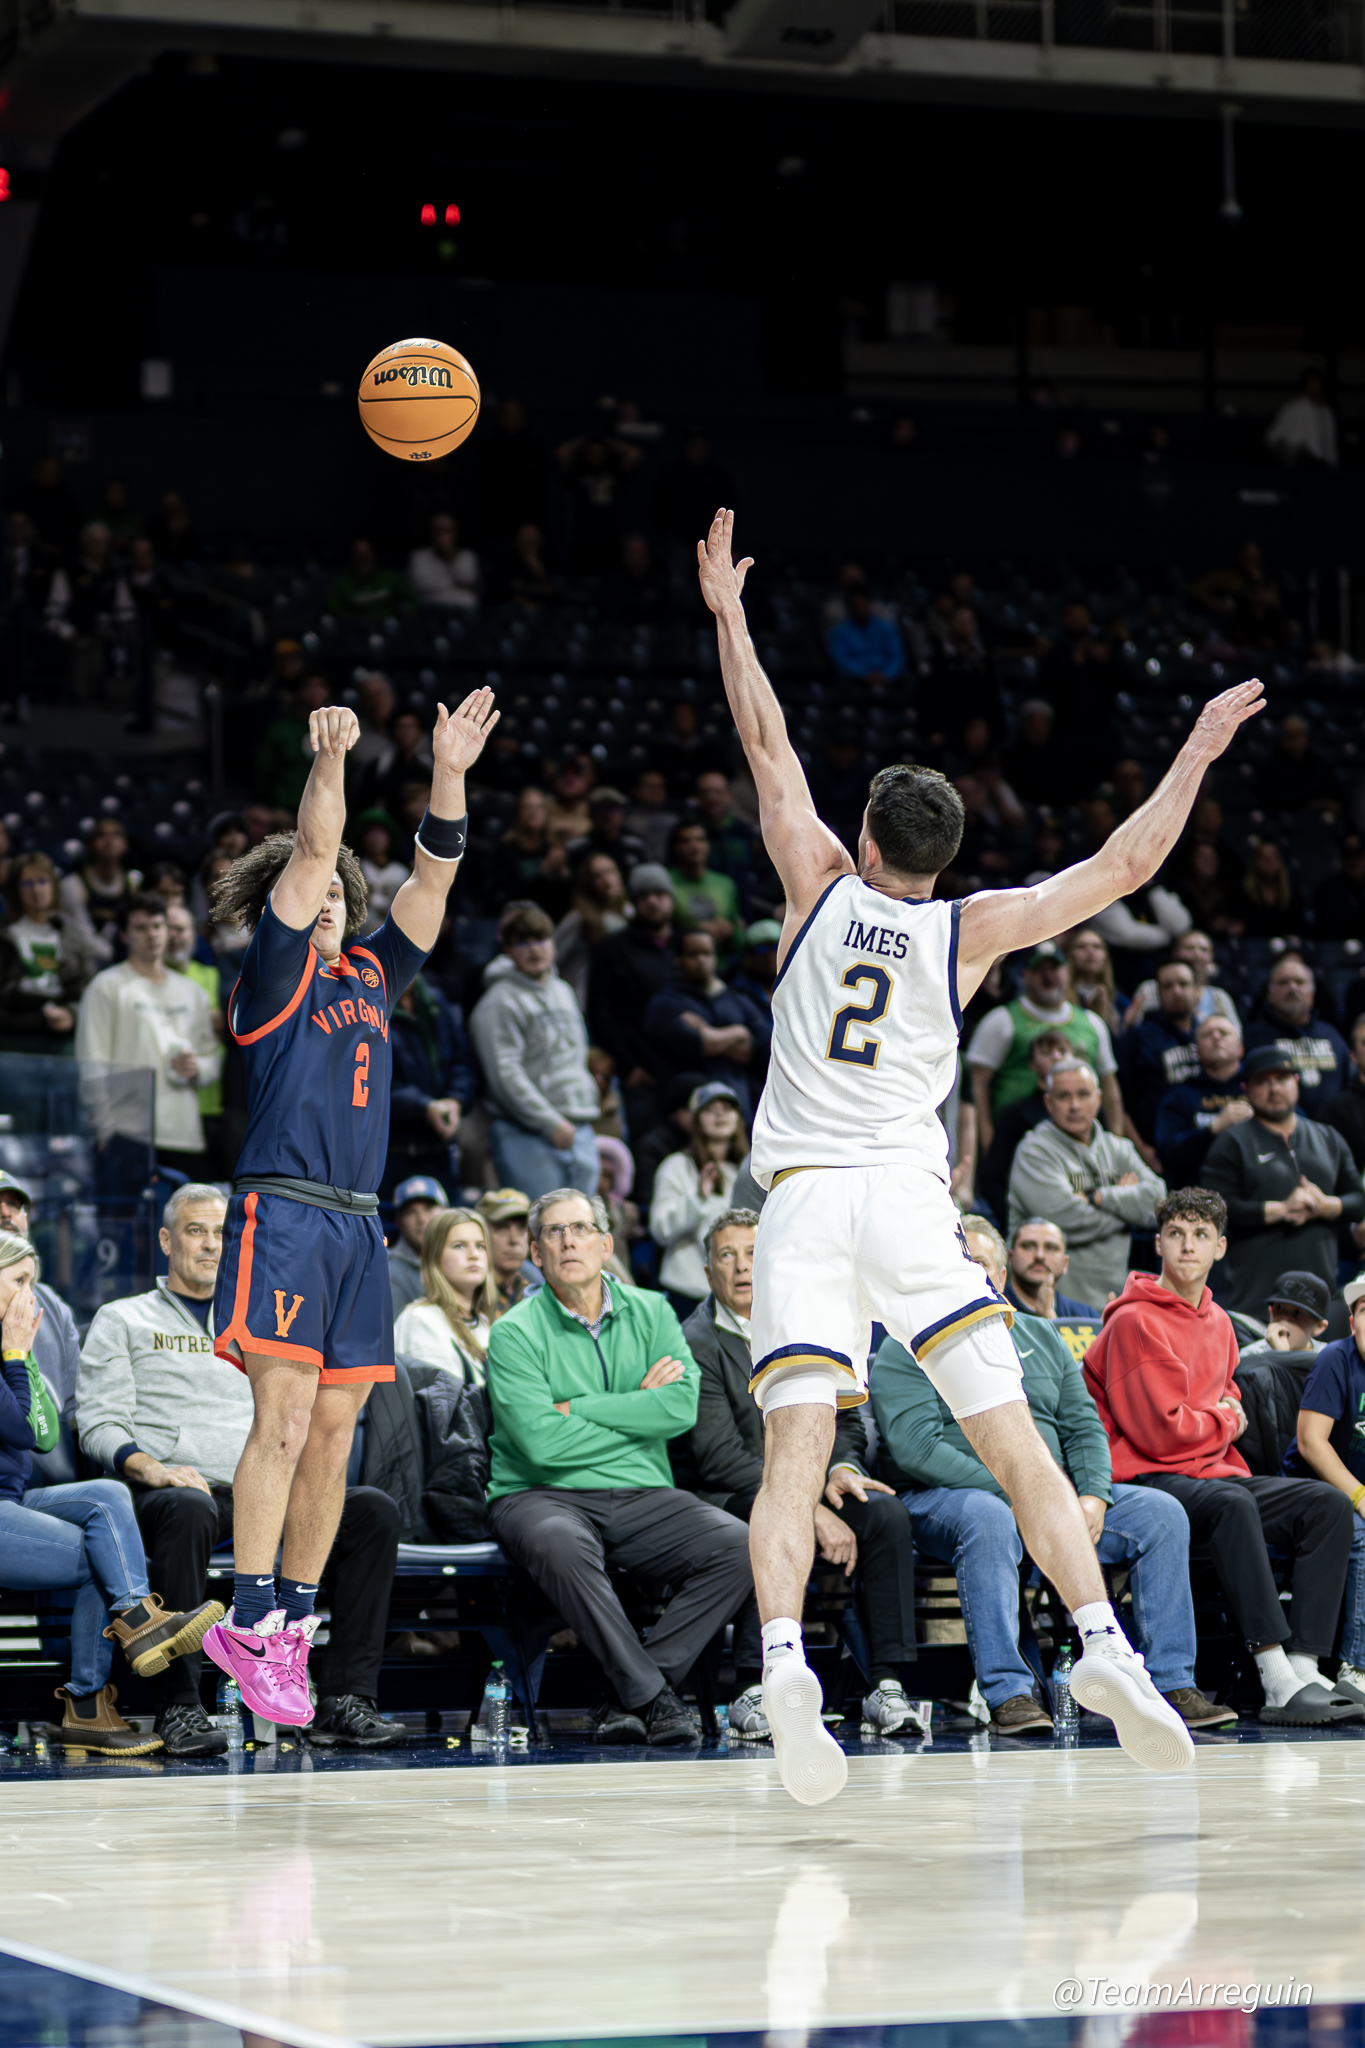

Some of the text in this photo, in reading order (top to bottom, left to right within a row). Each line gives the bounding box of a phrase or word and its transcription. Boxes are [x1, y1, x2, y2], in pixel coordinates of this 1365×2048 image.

[373, 365, 453, 389] Wilson
[843, 920, 910, 959] IMES
[311, 998, 388, 1043] VIRGNIA
[824, 960, 895, 1070] 2
[352, 1043, 370, 1108] 2
[274, 1290, 304, 1338] V
[153, 1332, 211, 1354] NOTRE
